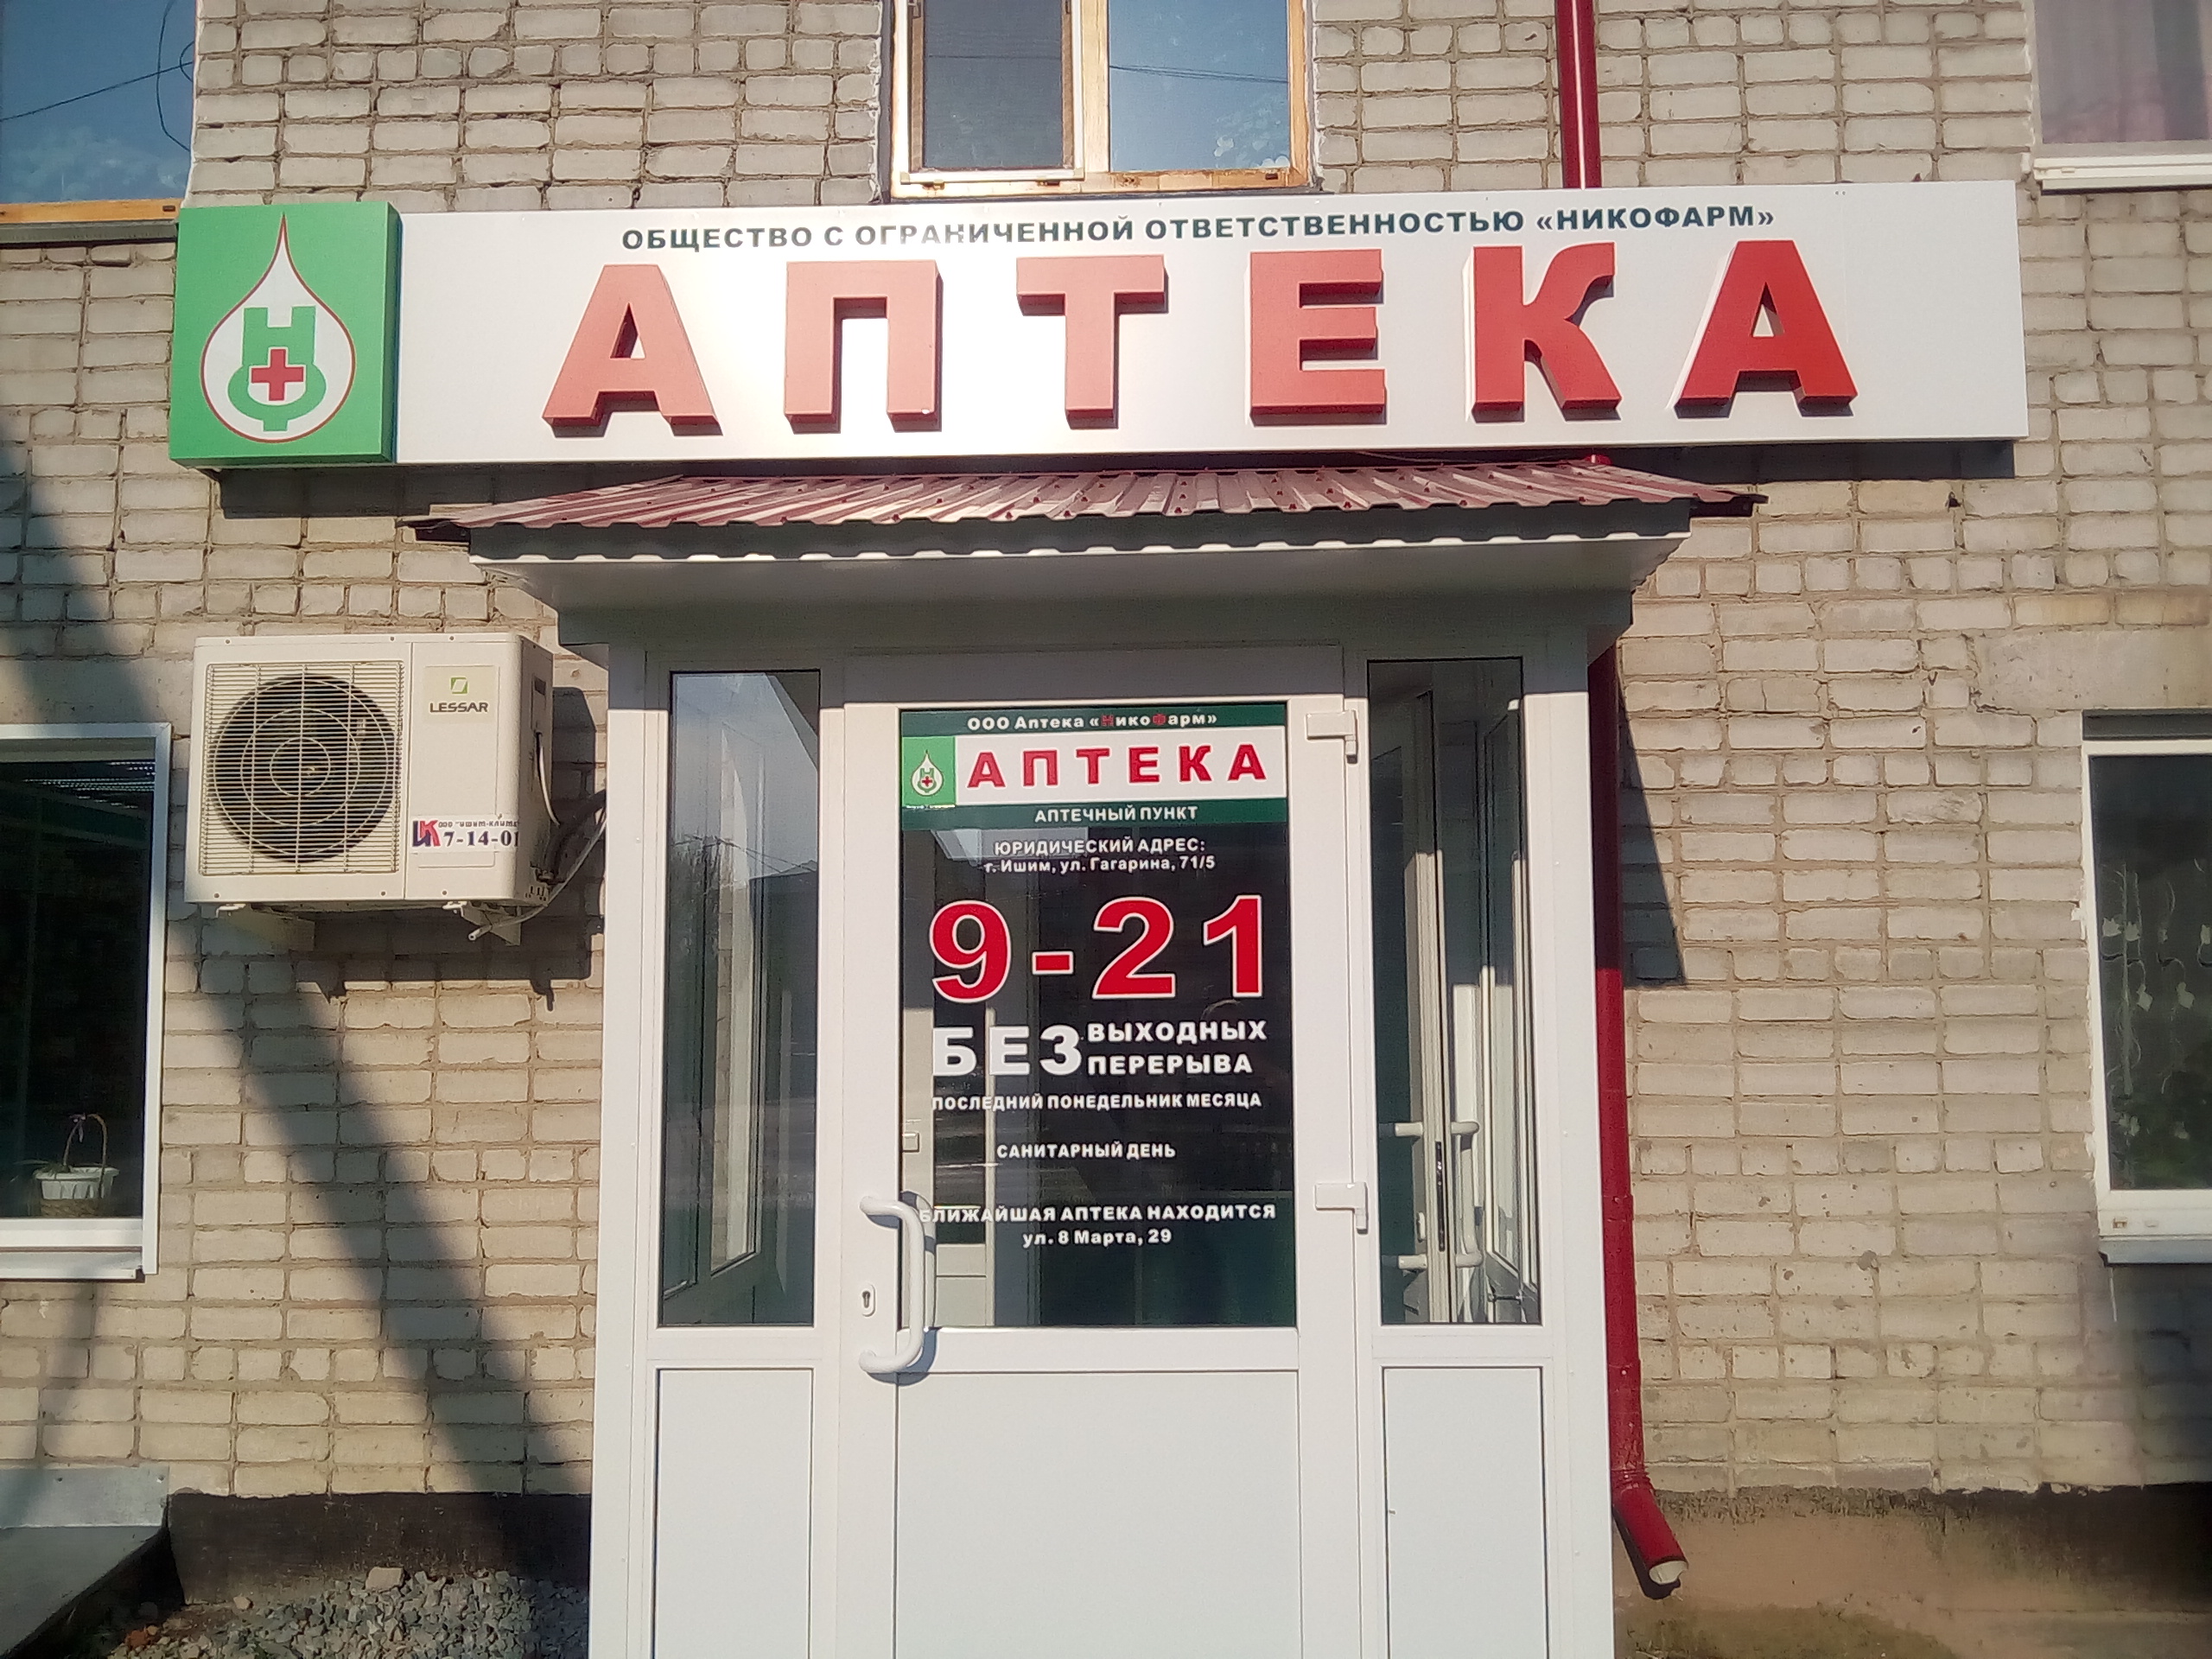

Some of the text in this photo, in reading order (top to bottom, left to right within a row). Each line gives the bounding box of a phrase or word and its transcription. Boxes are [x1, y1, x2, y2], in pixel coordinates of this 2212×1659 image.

[622, 206, 1775, 252] ОБЩЕСТВО С ОГРАНИЧЕННОЙ ОТВЕТСТВЕННОСТЬЮ «НИКОФАРМ»
[542, 239, 1859, 436] АПТЕКА
[429, 702, 489, 714] LESSAR
[967, 713, 1217, 731] ООО Аптека «НикоФарм»
[966, 743, 1268, 789] АПТЕКА
[1034, 804, 1198, 823] АПТЕЧНЫЙ ПУНКТ
[994, 836, 1206, 856] ЮРИДИЧЕСКИЙ АДРЕС:
[1000, 860, 1057, 875] Ишим,
[1060, 861, 1085, 874] ул.
[1089, 857, 1176, 874] Гагарина,
[1179, 856, 1216, 871] 71/5
[1086, 1020, 1268, 1045] ВЫХОДНЫХ
[931, 1025, 1083, 1077] БЕЗ
[1086, 1053, 1253, 1076] ПЕРЕРЫВА
[931, 1092, 1262, 1112] ПОСЛЕДНИЙ ПОНЕДЕЛЬНИК МЕСЯЦА
[996, 1141, 1177, 1160] САНИТАРНЫЙ ДЕНЬ
[918, 1204, 1276, 1223] БЛИЖАЙШАЯ АПТЕКА НАХОДИТСЯ
[1022, 1229, 1173, 1249] ул. 8 Марта, 29
